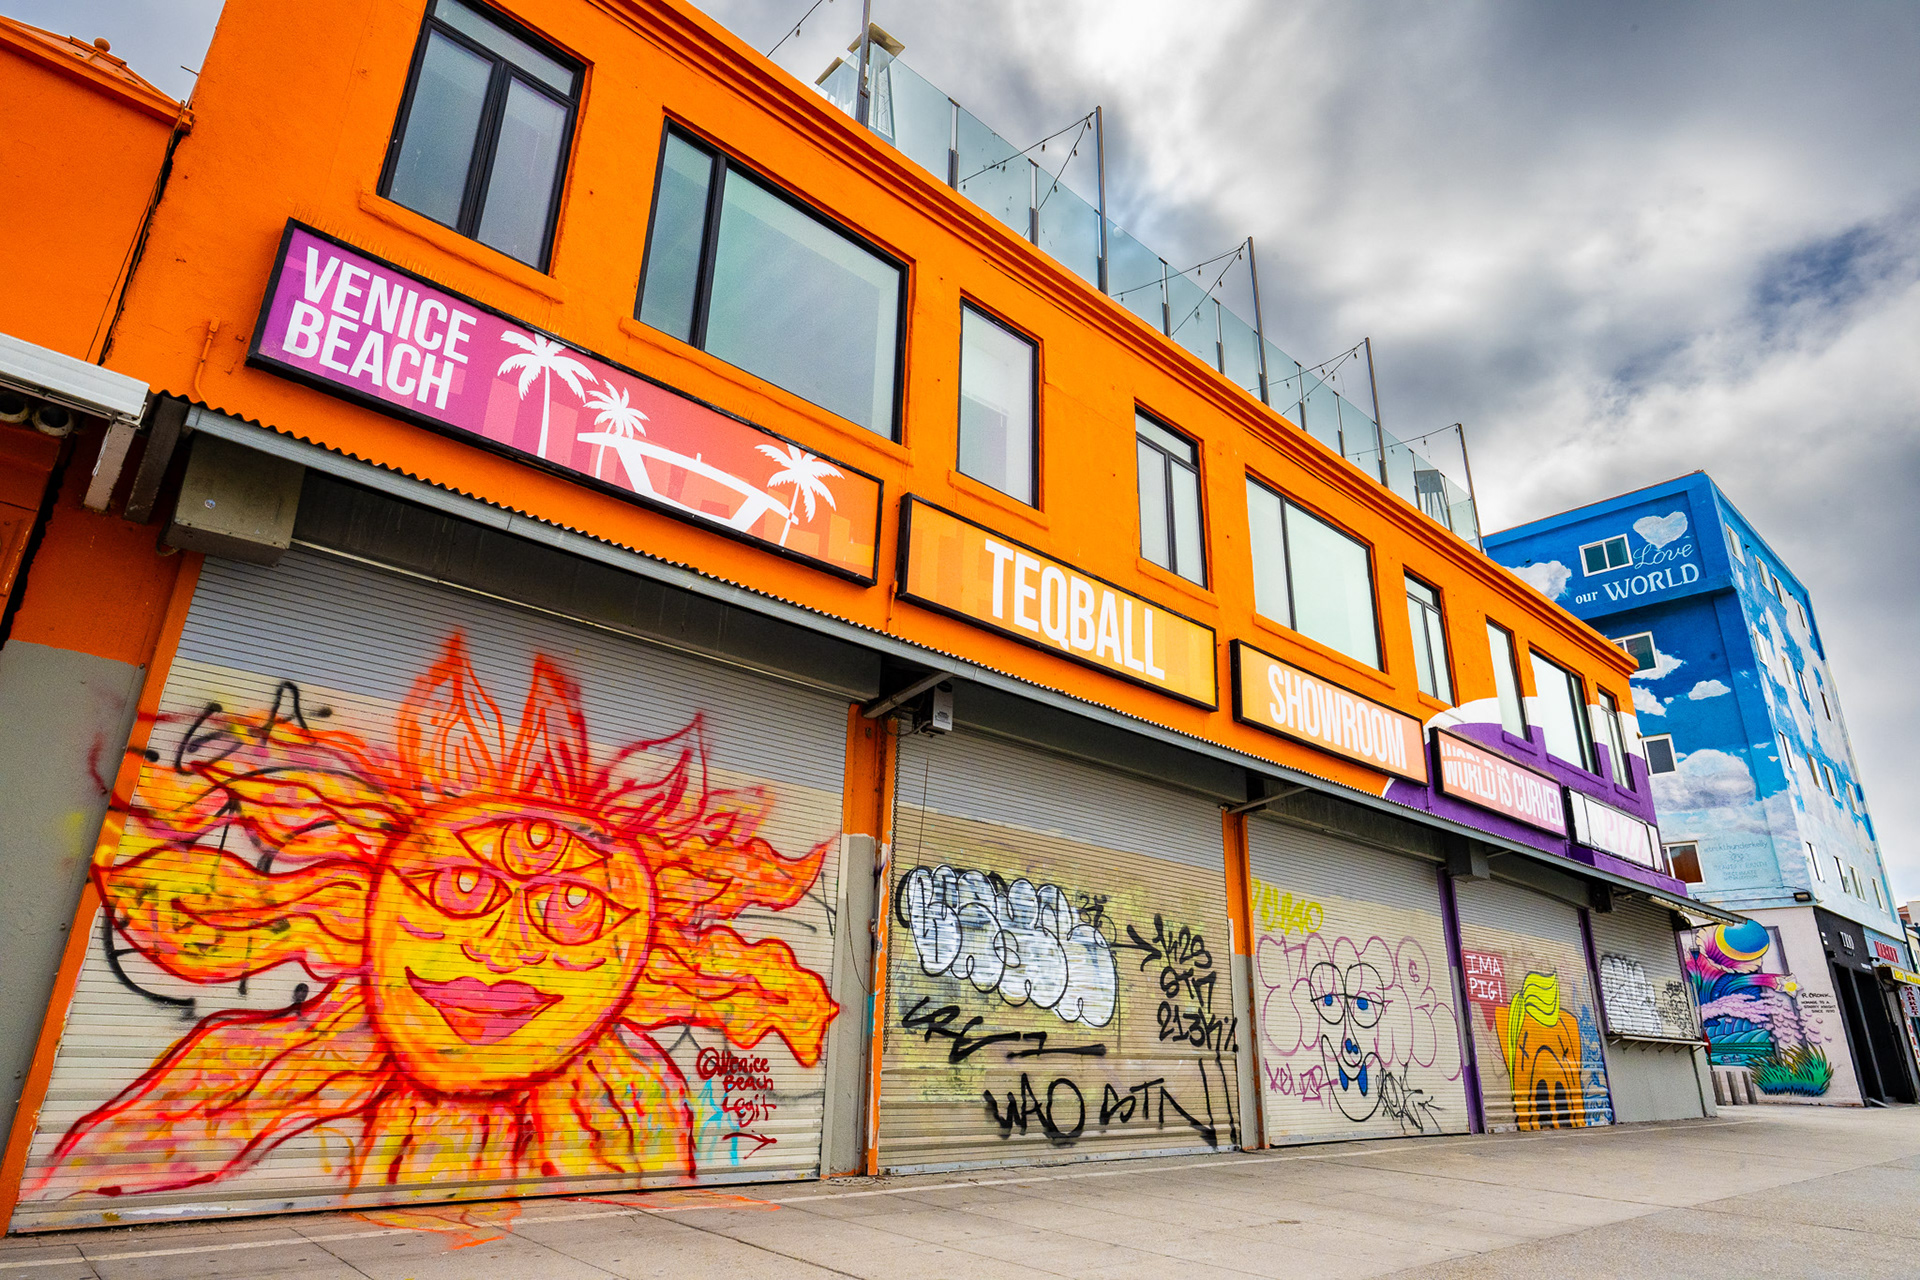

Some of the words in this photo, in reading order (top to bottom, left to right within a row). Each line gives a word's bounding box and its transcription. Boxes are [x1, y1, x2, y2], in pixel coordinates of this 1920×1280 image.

[304, 246, 477, 364] VENICE
[282, 300, 455, 410] BEACH
[1632, 543, 1694, 570] Love
[1575, 591, 1598, 605] our
[1602, 563, 1700, 601] WORLD
[985, 538, 1165, 681] TEQBALL
[1267, 664, 1407, 771] SHOWROOM
[1440, 740, 1498, 802] WORLD
[1496, 764, 1513, 808] IS
[1512, 772, 1565, 827] CURVED
[1469, 977, 1503, 1003] PIG!
[1904, 986, 1919, 1016] MARKET
[696, 1047, 770, 1080] @Venice
[722, 1074, 774, 1093] Beach
